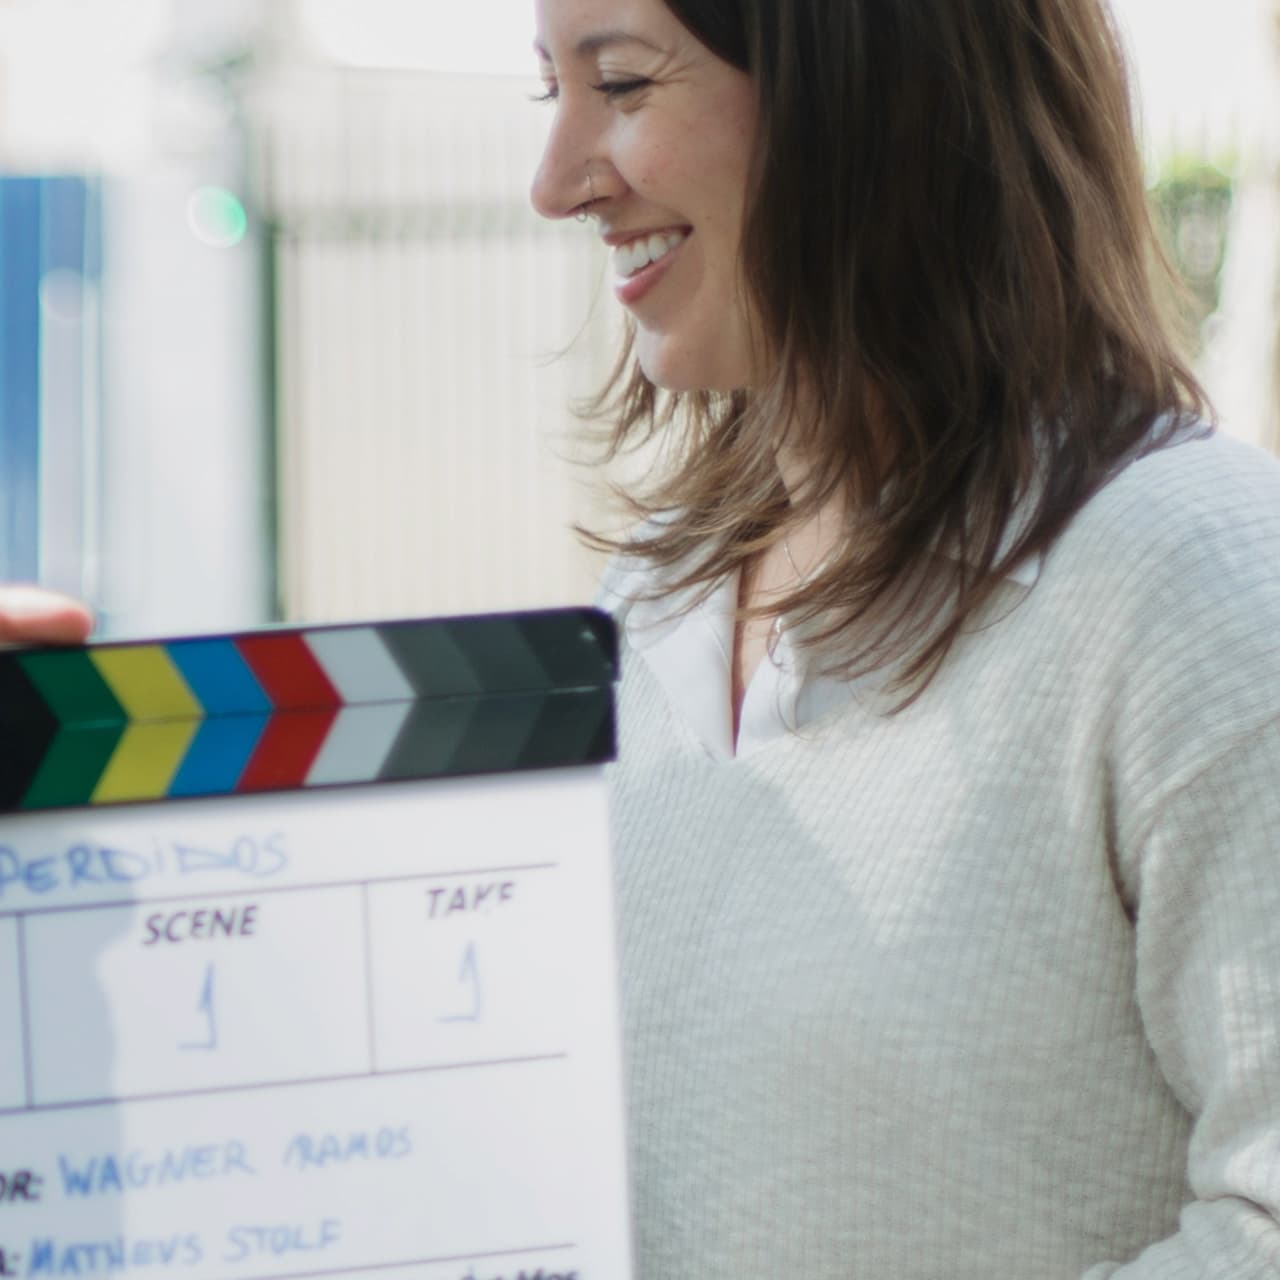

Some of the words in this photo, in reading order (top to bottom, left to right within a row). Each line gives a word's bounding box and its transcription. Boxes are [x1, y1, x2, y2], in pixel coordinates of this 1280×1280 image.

[142, 904, 258, 947] SCENE
[426, 881, 515, 919] TAKE
[177, 960, 217, 1051] 1
[438, 940, 481, 1023] 1
[57, 1138, 257, 1197] WAGNER
[283, 1126, 412, 1171] RAMOS
